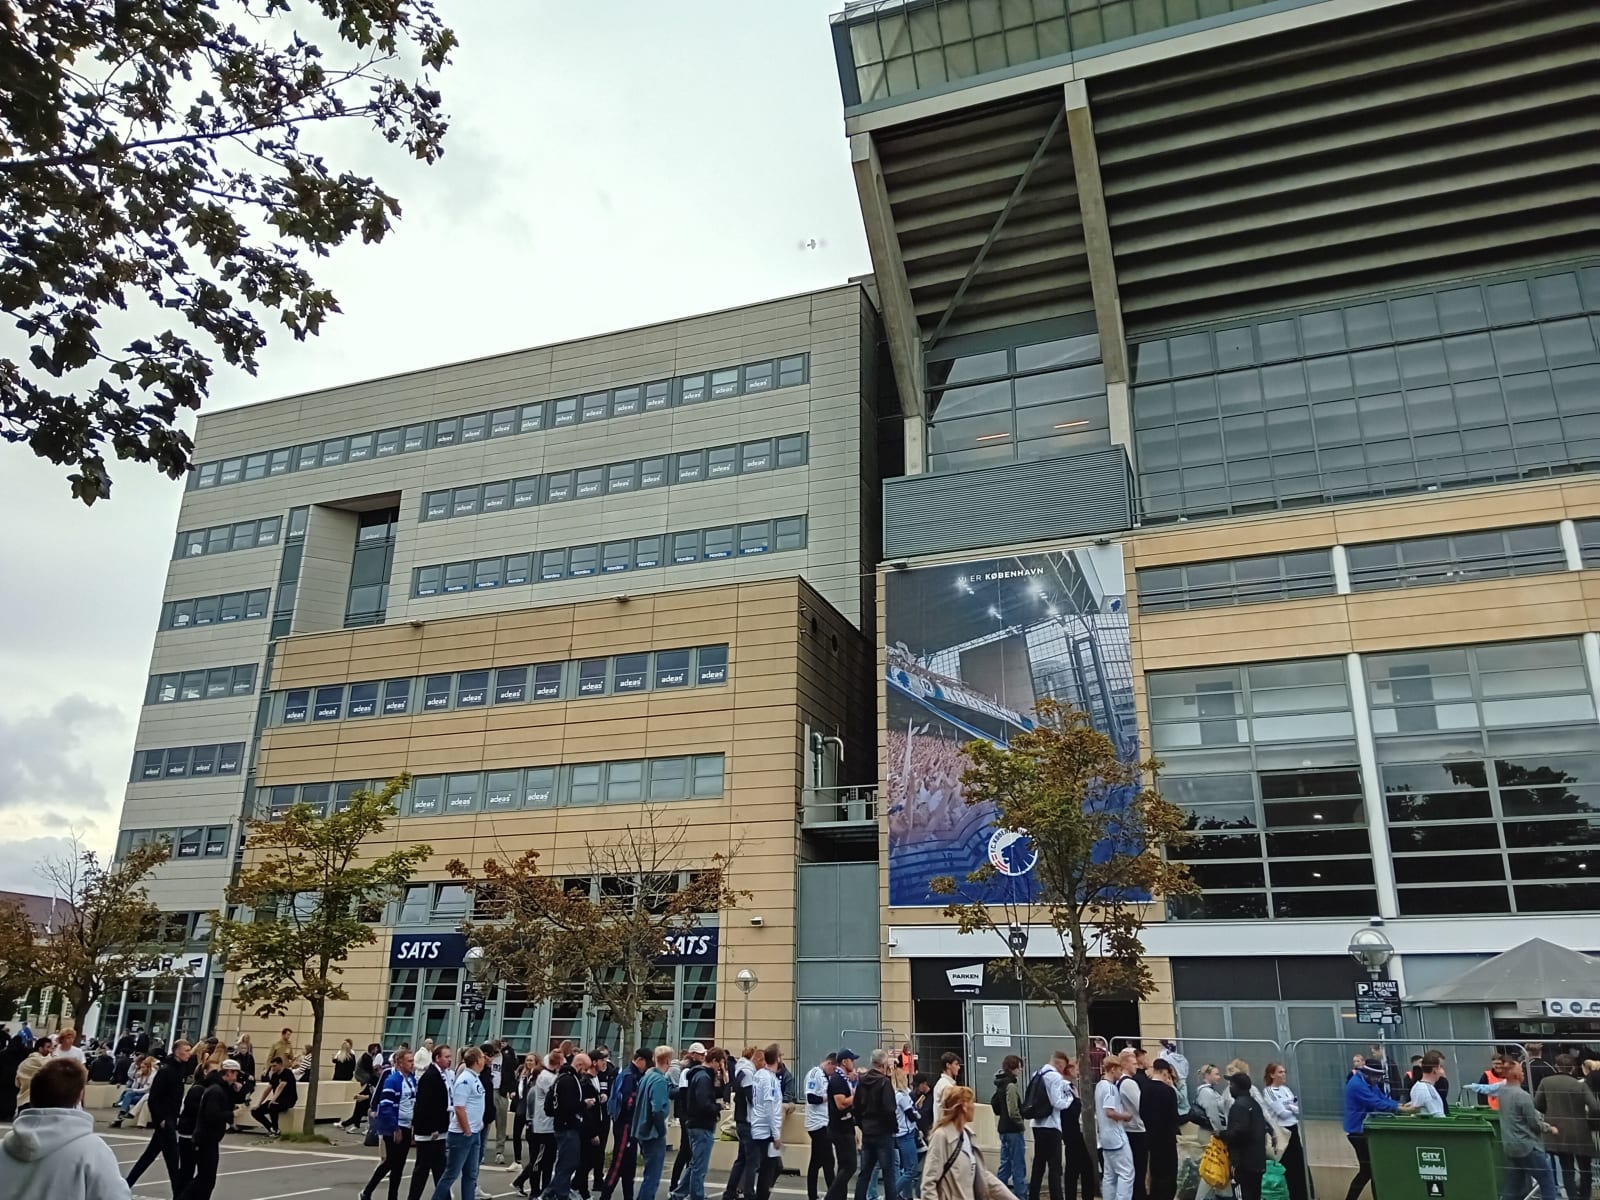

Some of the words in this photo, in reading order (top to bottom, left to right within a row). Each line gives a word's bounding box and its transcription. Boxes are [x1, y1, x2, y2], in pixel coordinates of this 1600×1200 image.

[970, 574, 982, 583] ER
[985, 567, 1044, 581] KØBENHAVN
[661, 673, 684, 683] adeas
[701, 669, 724, 679] adeas
[581, 680, 604, 691] adeas
[620, 677, 642, 687] adeas
[500, 689, 521, 699] adeas
[536, 685, 558, 695] adeas
[427, 696, 448, 706] adeas
[462, 692, 483, 702] adeas
[451, 796, 472, 806] adeas
[490, 793, 511, 803] adeas
[527, 791, 549, 801] adeas
[415, 799, 436, 808] adeas
[397, 941, 441, 959] SATS
[660, 935, 711, 955] SATS
[464, 983, 471, 992] P
[1358, 983, 1369, 996] P
